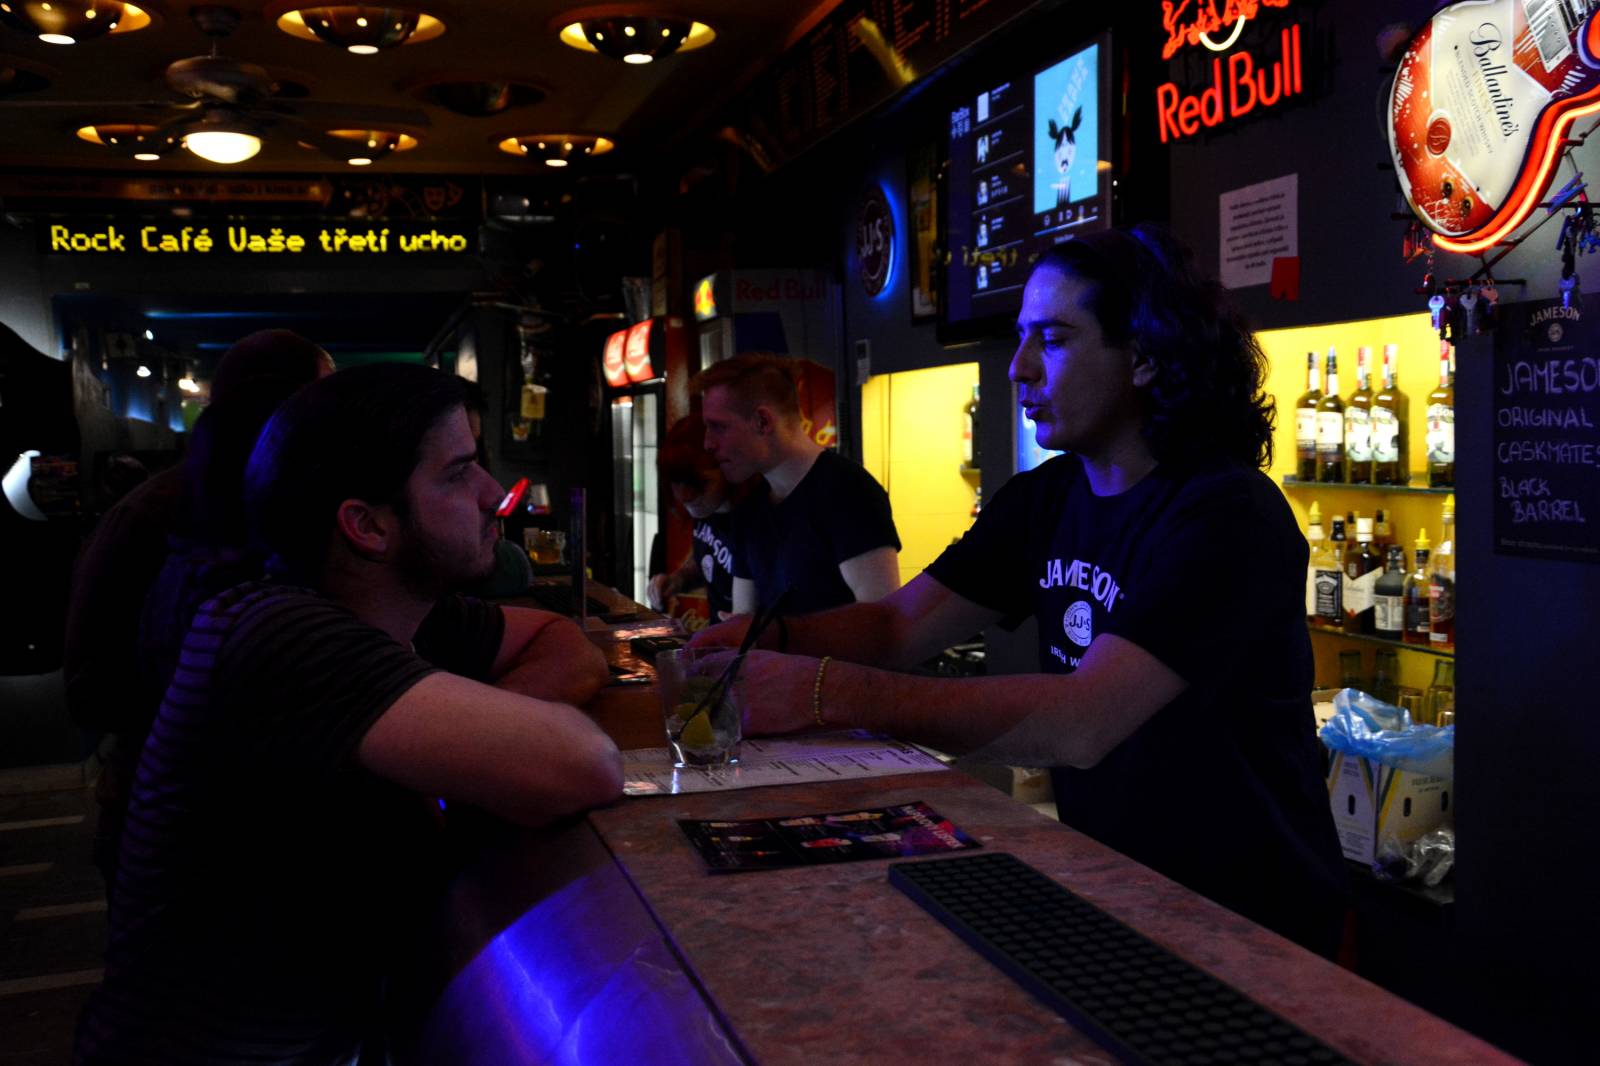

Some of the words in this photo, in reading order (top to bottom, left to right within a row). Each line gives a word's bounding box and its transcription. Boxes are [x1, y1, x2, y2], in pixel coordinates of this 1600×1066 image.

[1157, 57, 1224, 144] Red
[1228, 23, 1303, 118] Bull
[1470, 22, 1519, 137] Ballantine's
[51, 225, 125, 251] Rock
[141, 227, 213, 252] Café
[229, 227, 305, 252] Vaše
[319, 228, 389, 252] třetí
[400, 230, 466, 252] ucho
[736, 277, 780, 301] Red
[784, 277, 826, 301] Bull
[1529, 306, 1581, 327] JAMESON
[1502, 357, 1600, 395] JAMESO
[1498, 406, 1594, 429] ORIGINAL
[1498, 475, 1551, 498] BLACK
[1511, 500, 1585, 524] BARREL
